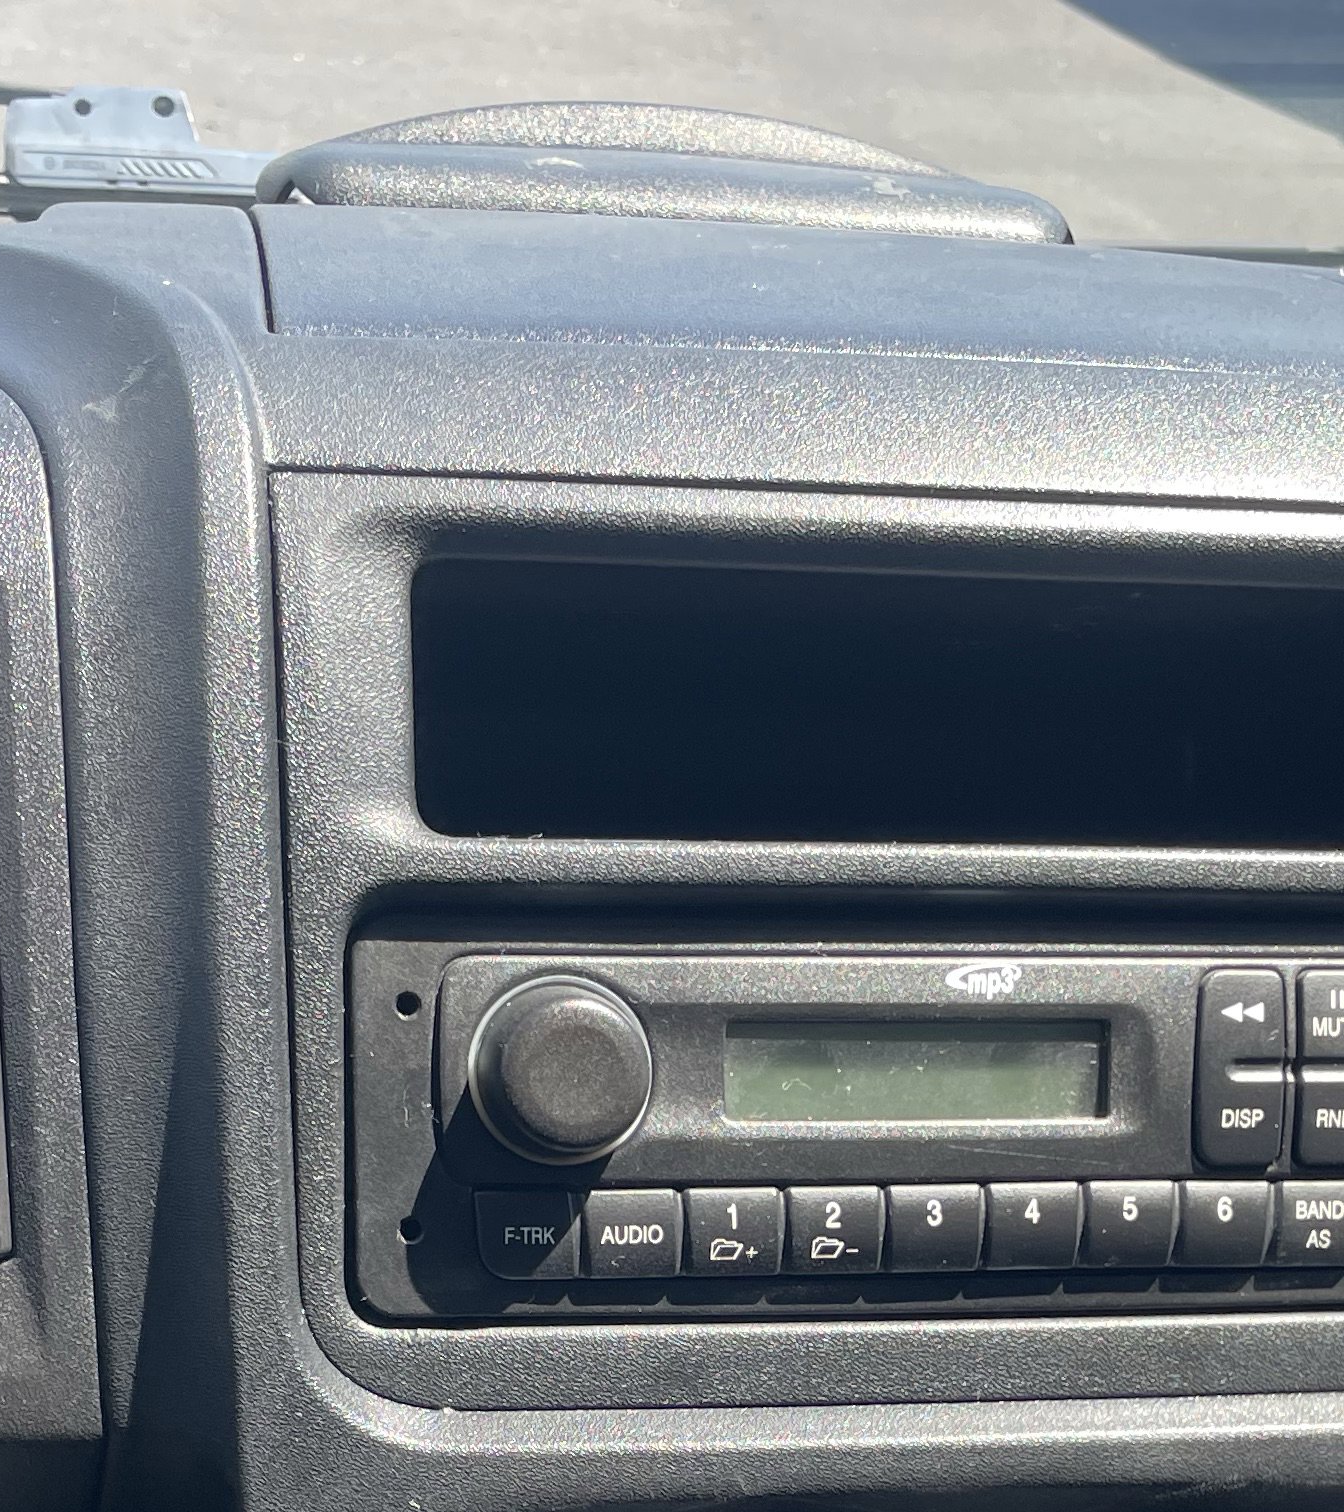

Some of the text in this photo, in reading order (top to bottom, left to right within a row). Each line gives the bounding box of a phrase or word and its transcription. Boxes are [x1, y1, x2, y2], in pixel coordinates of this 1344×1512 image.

[1222, 1109, 1264, 1128] DISP
[727, 1203, 737, 1229] 1
[825, 1201, 841, 1229] 2
[926, 1199, 943, 1227] 3
[1024, 1198, 1041, 1224] 4
[1122, 1195, 1138, 1221] 5
[1217, 1195, 1233, 1222] 6
[1296, 1200, 1344, 1219] BAND
[504, 1227, 556, 1246] F-TRK
[601, 1225, 663, 1244] AUDIO
[1306, 1229, 1331, 1248] AS
